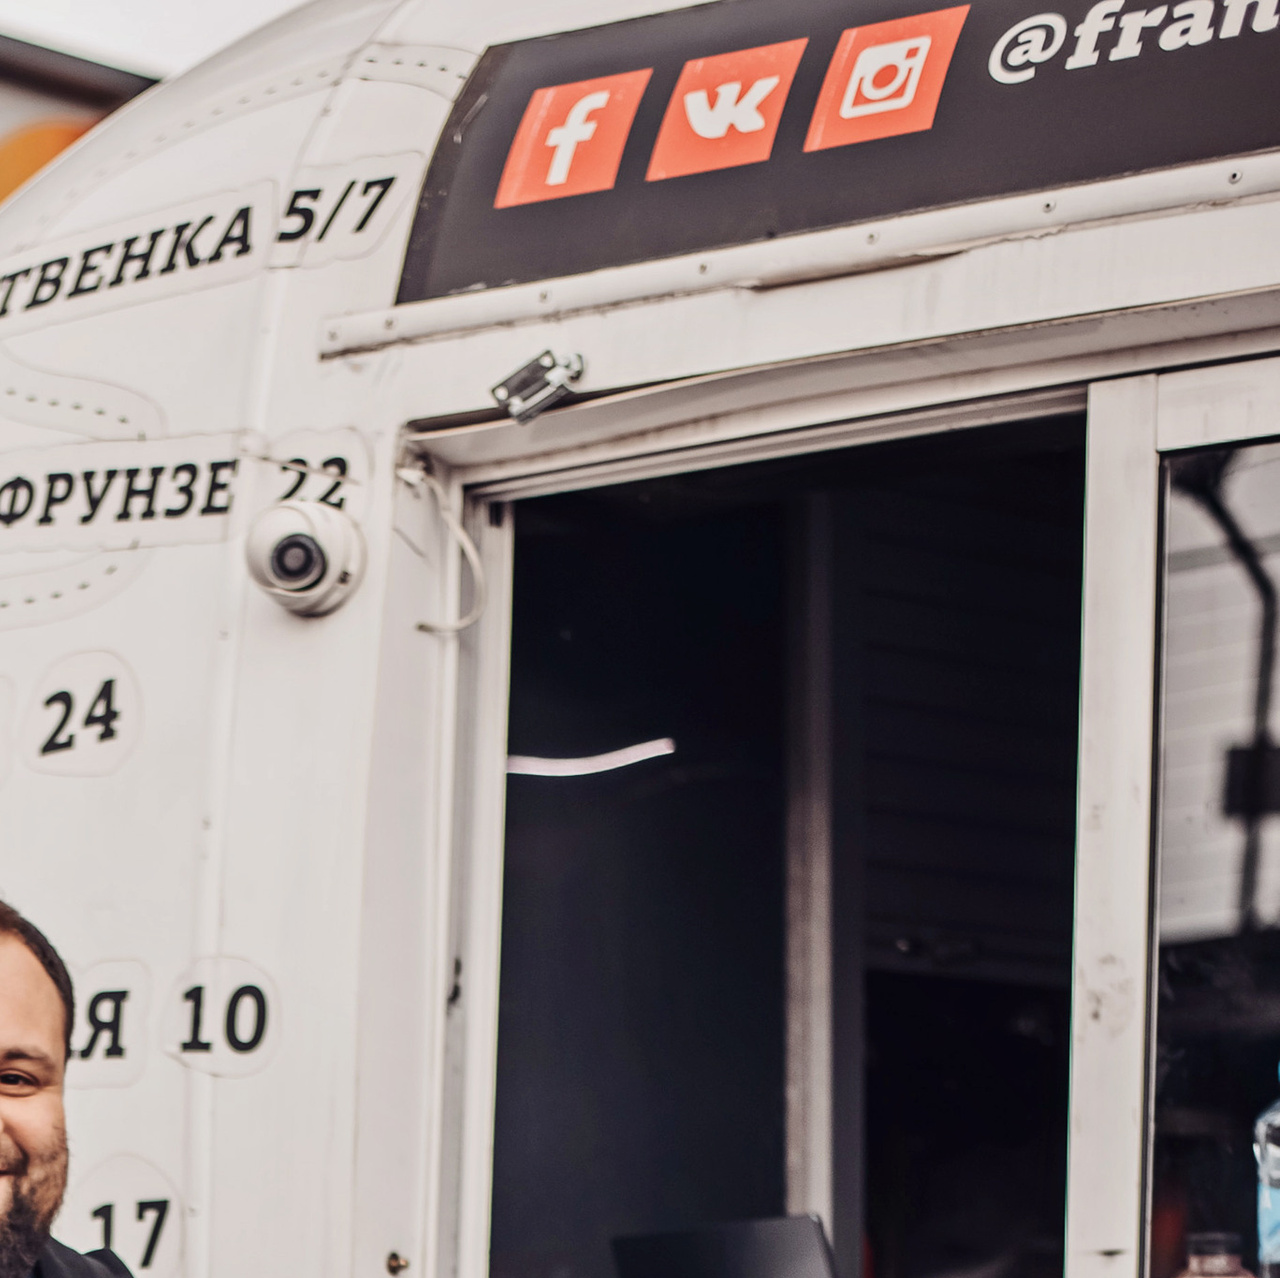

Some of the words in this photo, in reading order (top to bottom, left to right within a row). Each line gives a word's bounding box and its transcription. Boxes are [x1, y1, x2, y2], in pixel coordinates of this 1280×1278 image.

[276, 176, 397, 244] 5/7
[281, 456, 349, 511] 22
[40, 678, 121, 757] 24
[180, 984, 268, 1055] 10
[91, 1199, 171, 1269] 17
